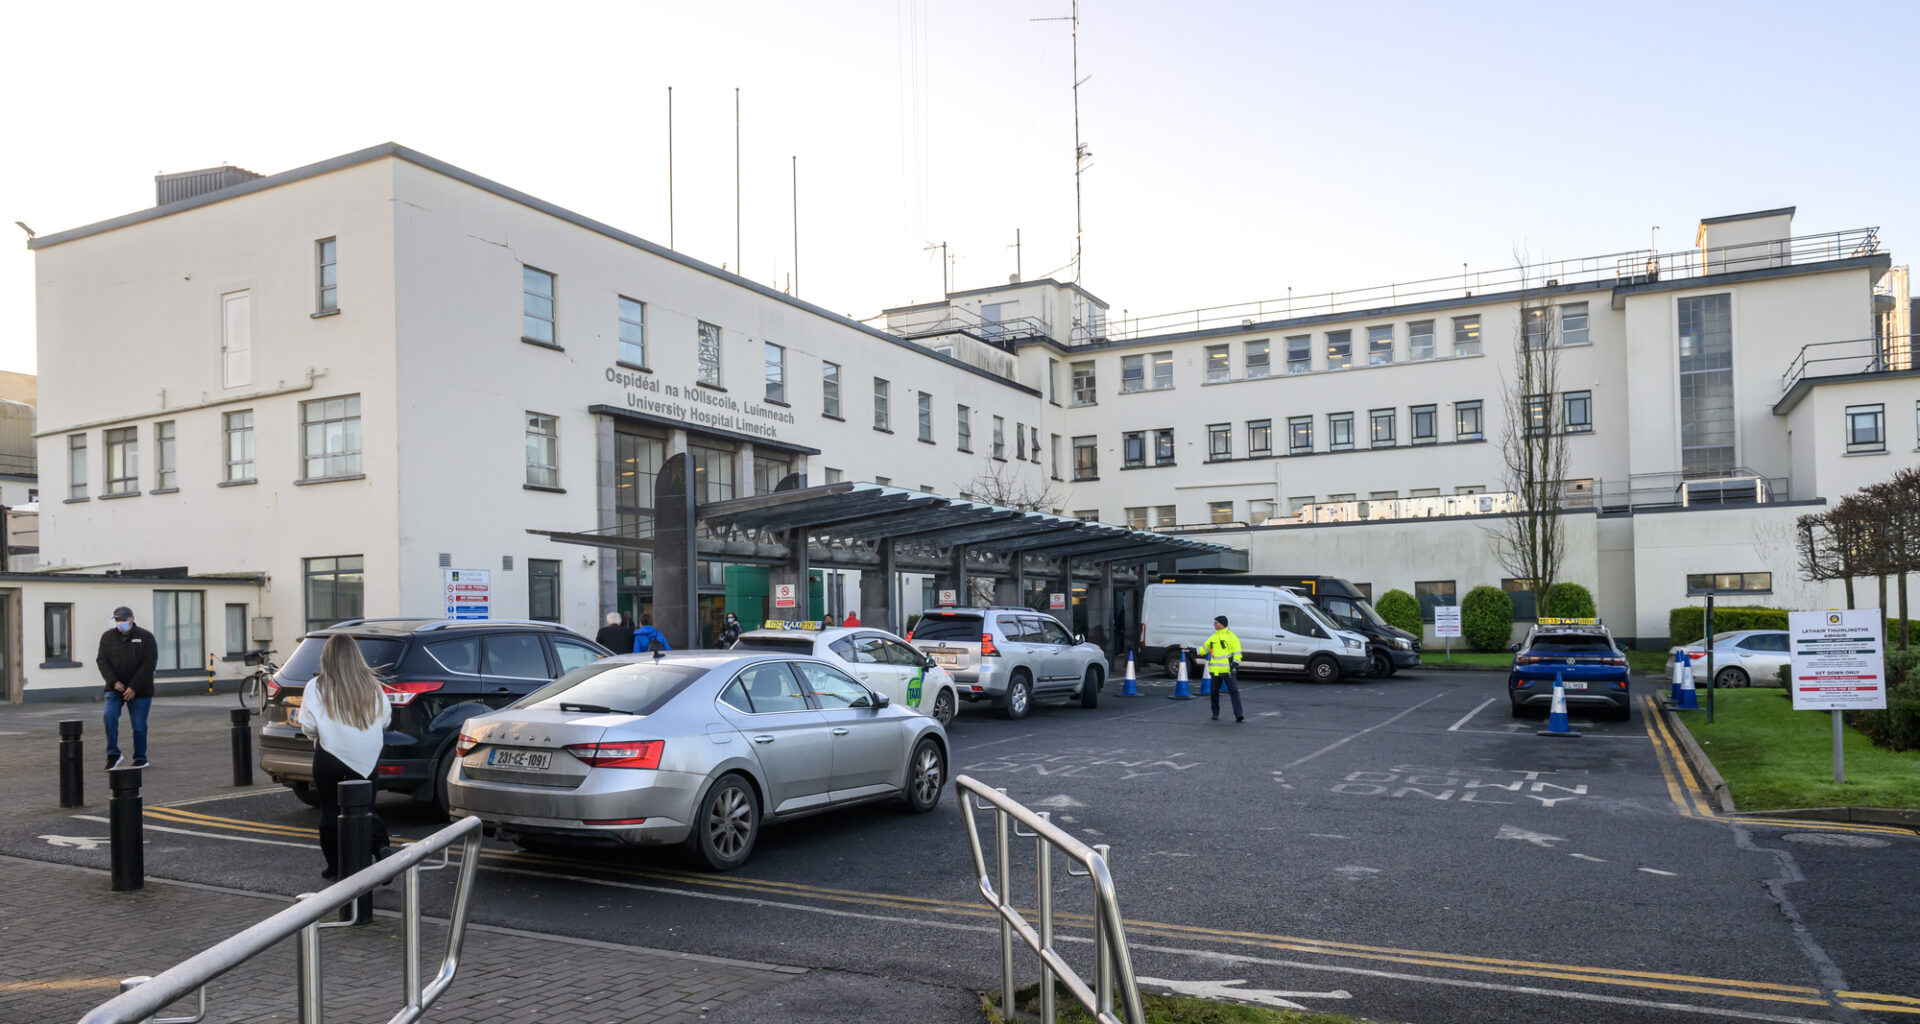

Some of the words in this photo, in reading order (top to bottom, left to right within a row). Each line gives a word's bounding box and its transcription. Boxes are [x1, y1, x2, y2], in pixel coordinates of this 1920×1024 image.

[605, 367, 660, 393] Ospidéal
[665, 383, 679, 397] na
[684, 386, 740, 413] hOllscoile,
[744, 401, 795, 425] Luimneach
[627, 392, 687, 421] University
[690, 407, 734, 428] Hospital
[736, 417, 777, 438] Limerick
[785, 620, 802, 629] TAXI
[909, 688, 920, 699] TAXI
[497, 751, 547, 767] 231-CE-1091
[1329, 783, 1578, 807] ONLY
[1344, 771, 1588, 795] DOWN
